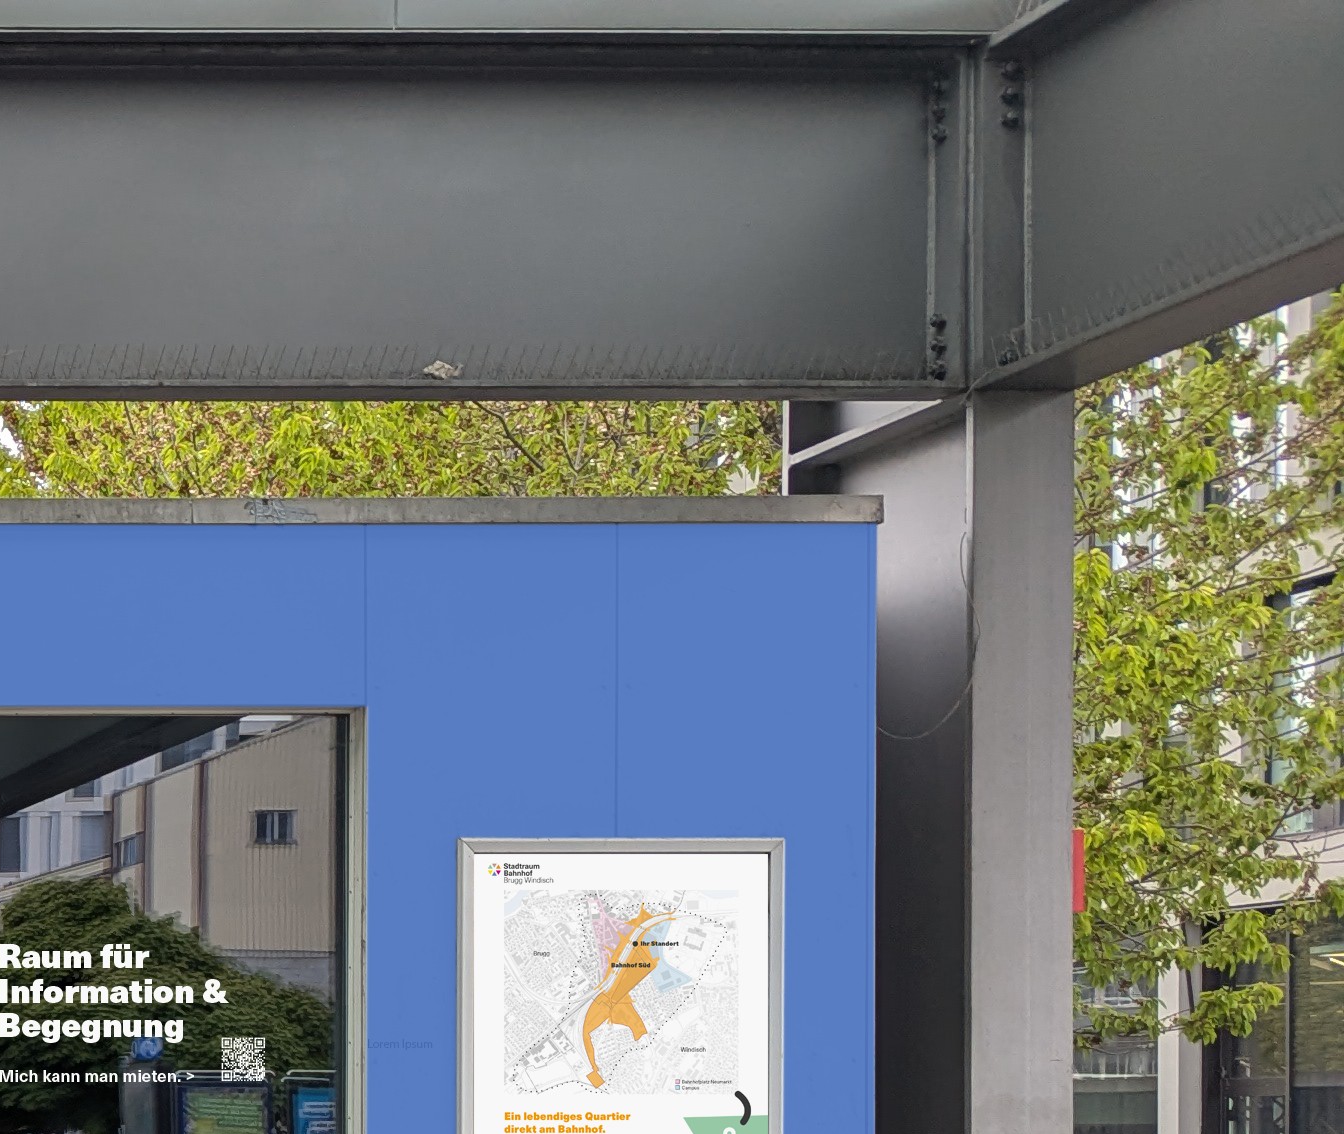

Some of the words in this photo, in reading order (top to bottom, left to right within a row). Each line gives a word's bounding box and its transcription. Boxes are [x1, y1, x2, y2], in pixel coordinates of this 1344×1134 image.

[504, 877, 523, 885] Brugg
[0, 944, 92, 969] Raum
[100, 944, 150, 969] für
[0, 979, 194, 1004] Information
[202, 979, 229, 1004] &
[0, 1013, 184, 1043] Begegnung
[0, 1069, 38, 1083] Mich
[43, 1069, 81, 1083] kann
[85, 1072, 118, 1083] man
[123, 1070, 181, 1083] mieten.
[504, 1112, 521, 1120] Ein
[523, 1112, 582, 1122] lebendiges
[585, 1112, 631, 1121] Quartier
[504, 1125, 536, 1133] direkt
[558, 1125, 606, 1133] Bahnhof.
